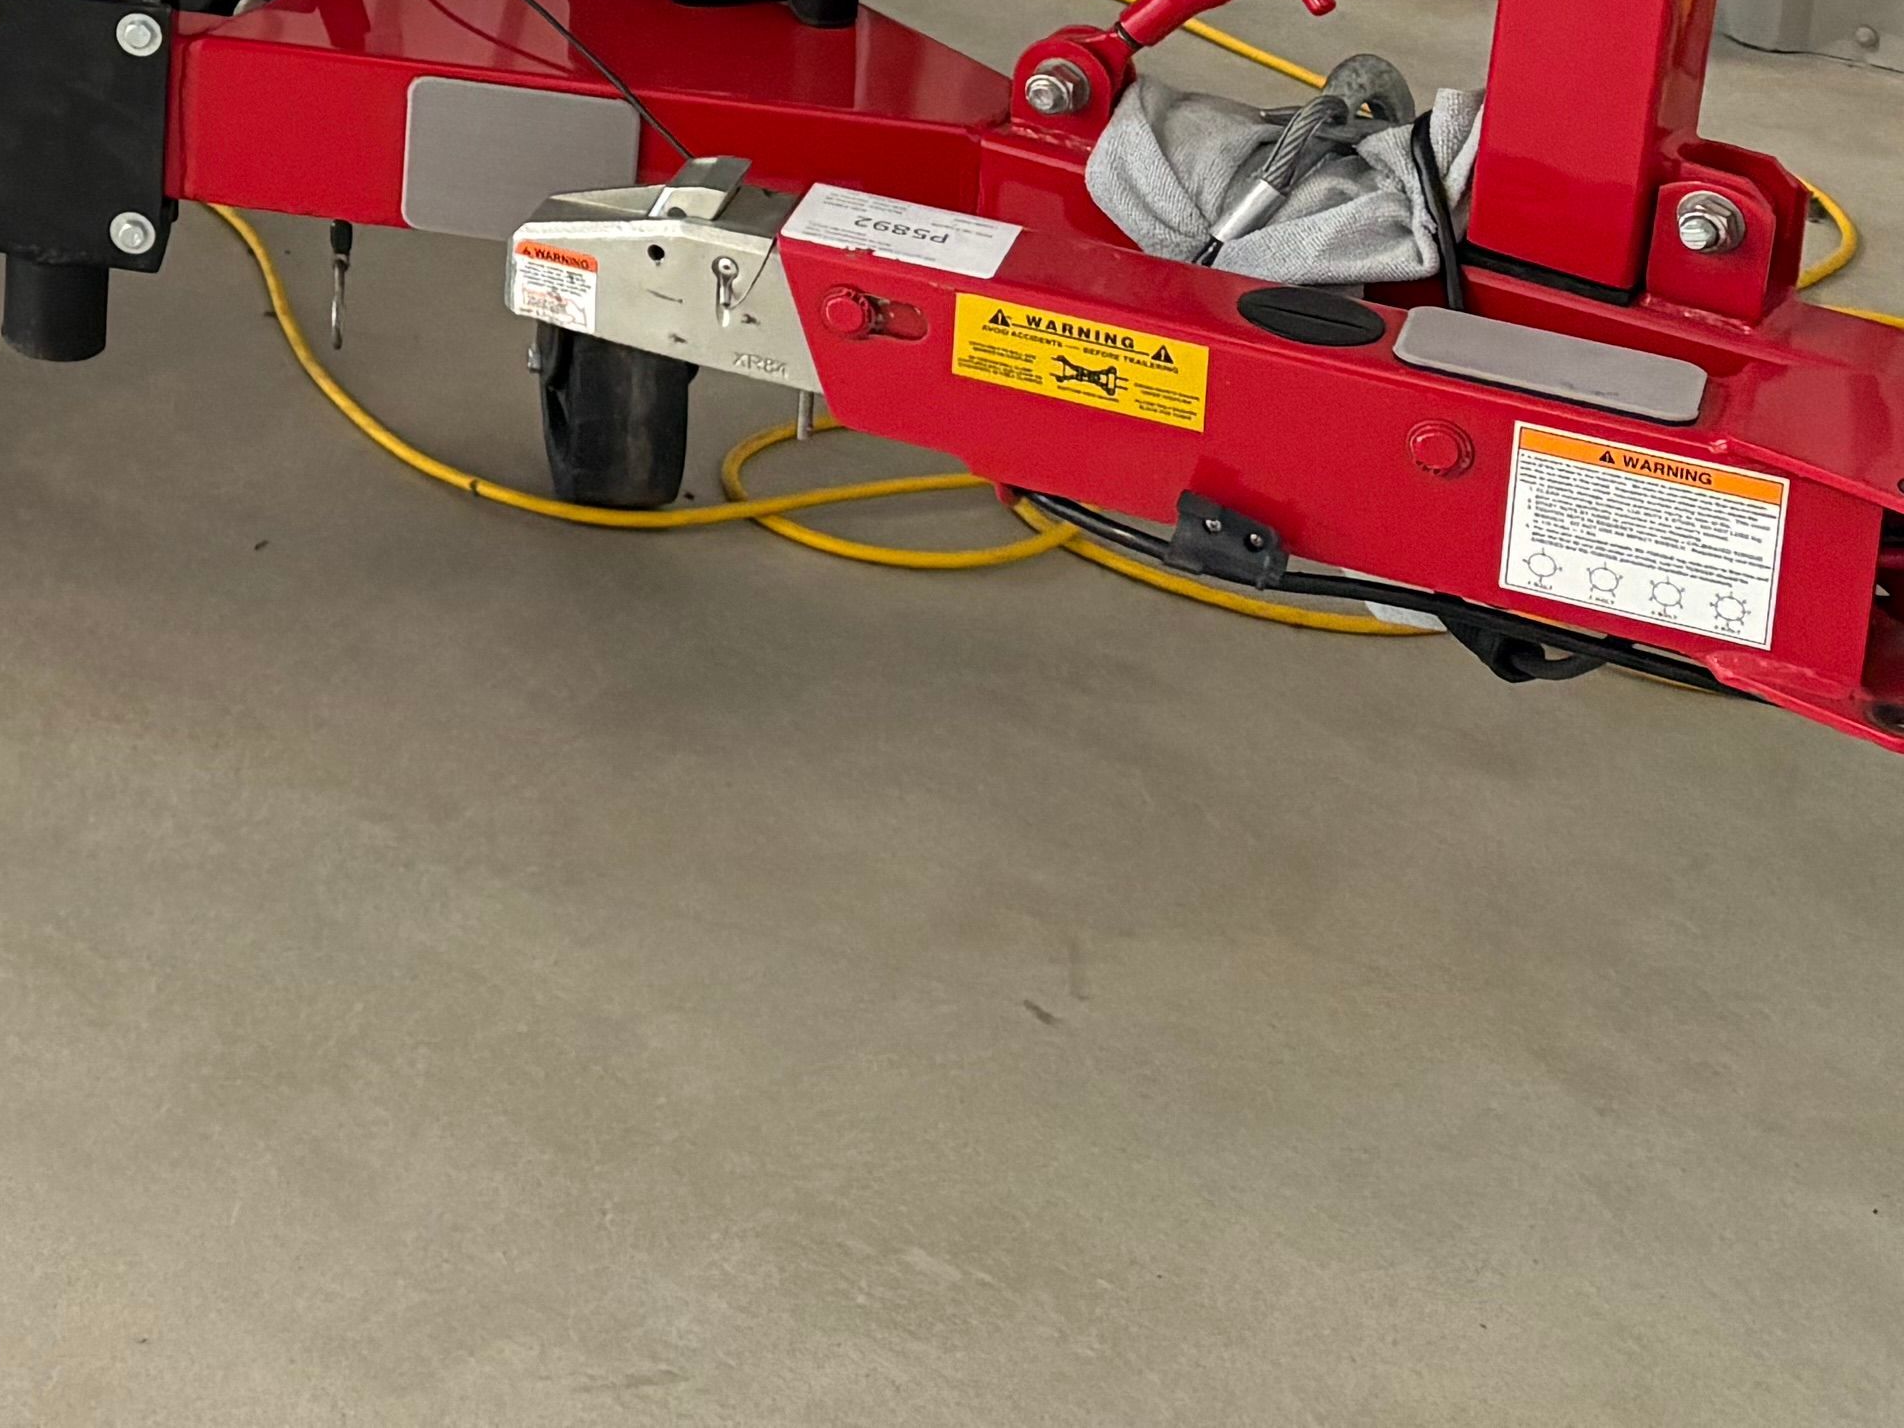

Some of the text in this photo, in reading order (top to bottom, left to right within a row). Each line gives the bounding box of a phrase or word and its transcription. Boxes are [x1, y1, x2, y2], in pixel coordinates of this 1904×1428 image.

[853, 214, 952, 245] P5892
[534, 246, 590, 270] WARNING
[1011, 330, 1063, 348] ACCIDENTS
[1082, 347, 1120, 361] BEFORE
[1025, 313, 1135, 350] WARNING
[1622, 454, 1713, 486] WARNING
